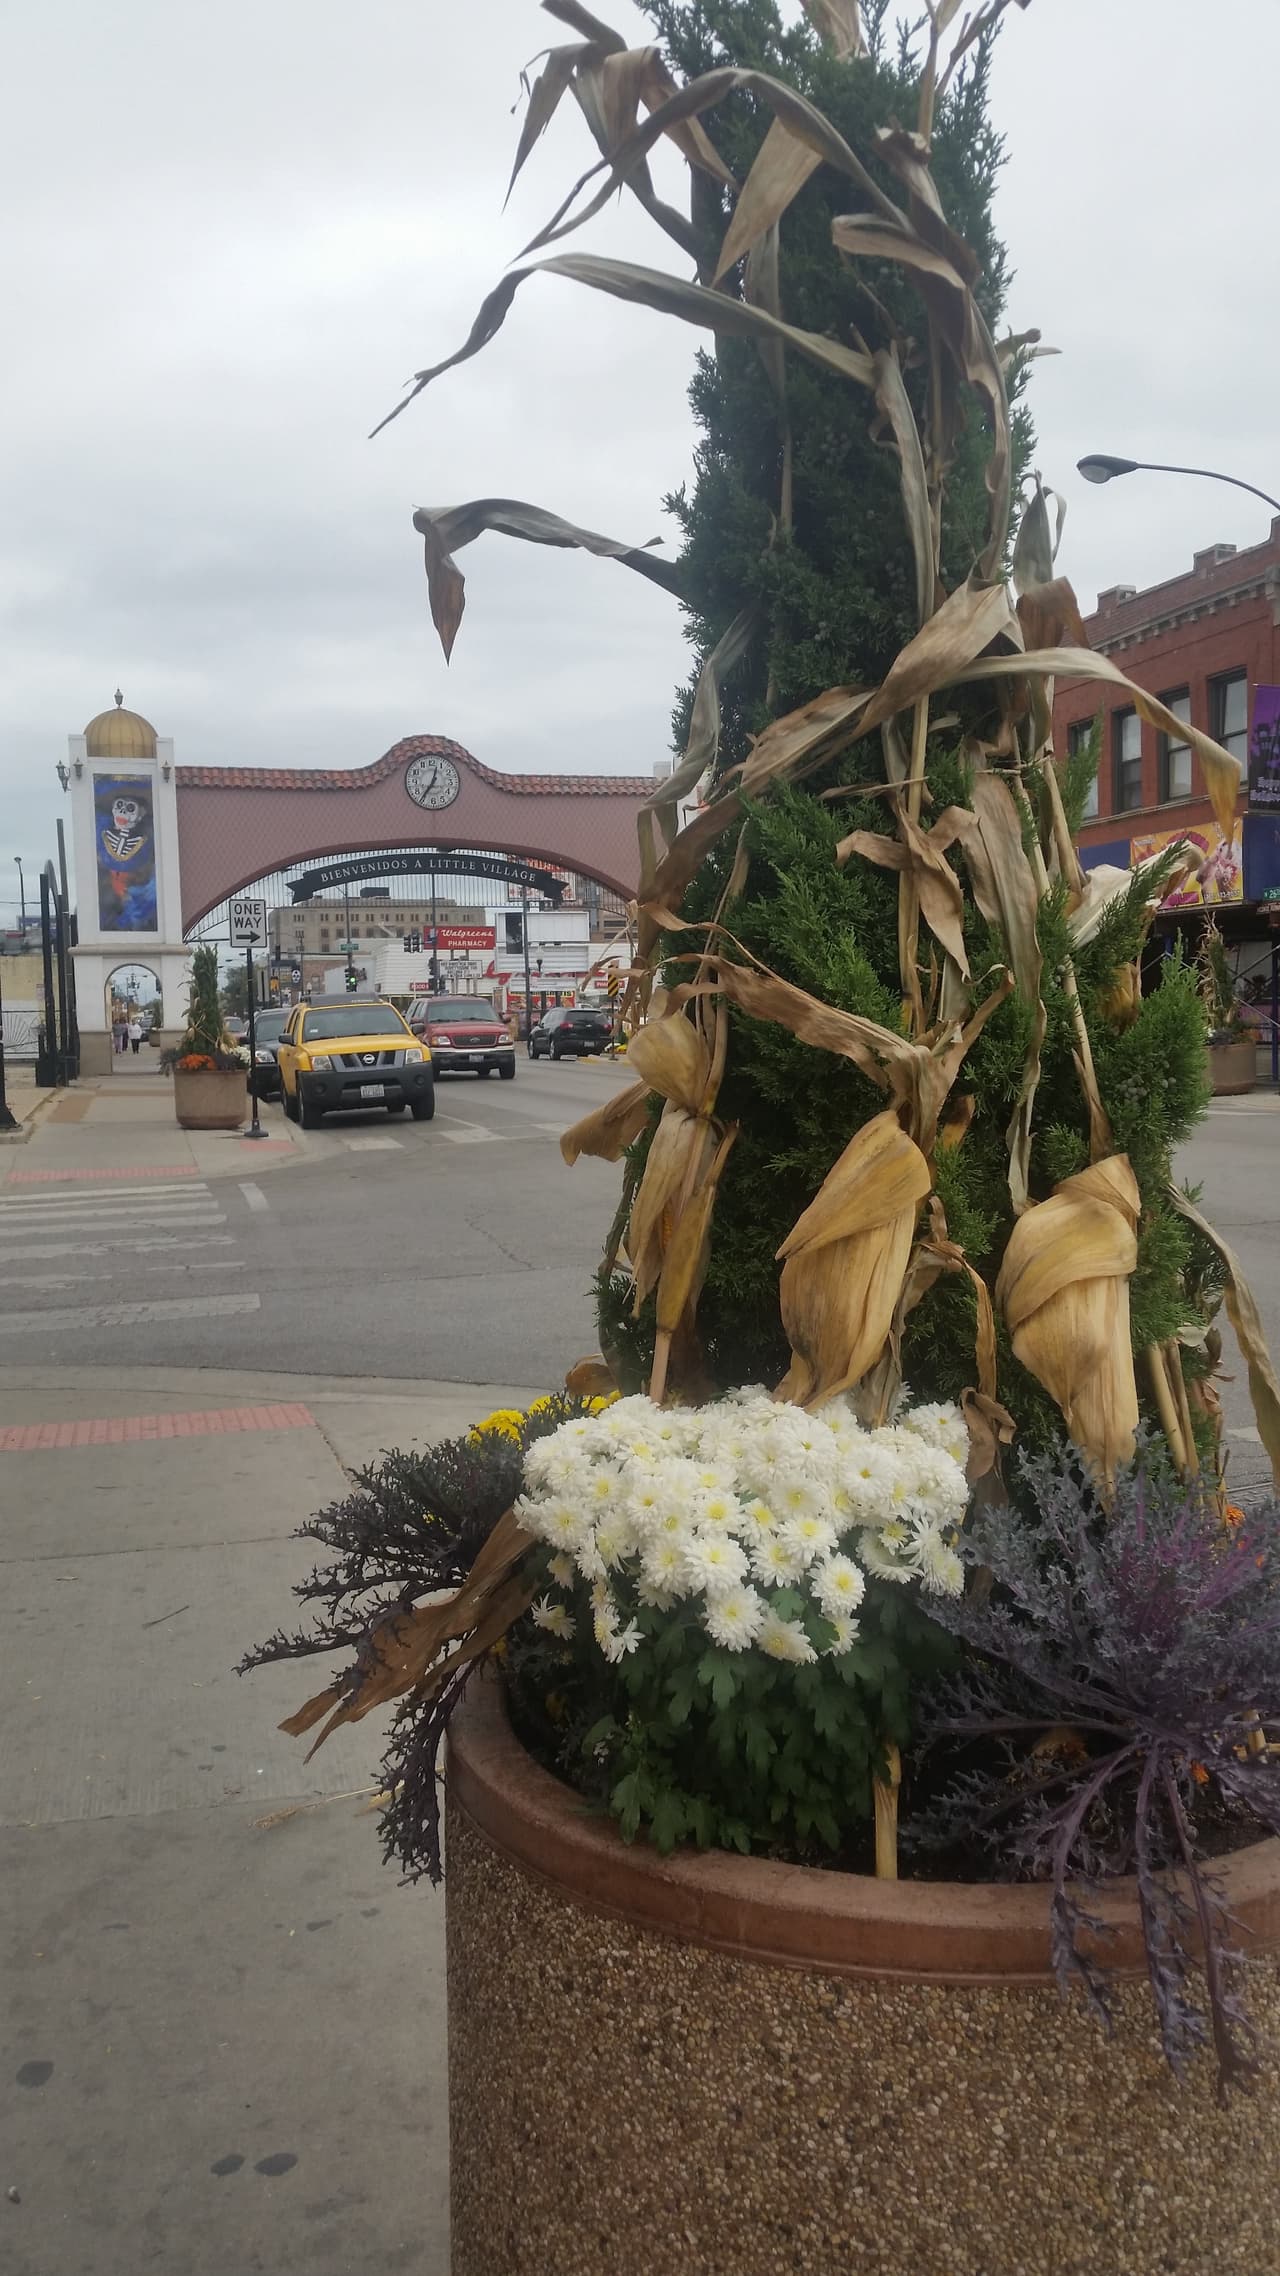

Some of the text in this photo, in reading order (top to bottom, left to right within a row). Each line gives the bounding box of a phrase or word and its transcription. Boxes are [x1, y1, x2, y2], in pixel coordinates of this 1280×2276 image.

[320, 859, 408, 882] BIENVENIDOS
[414, 859, 423, 868] A
[429, 859, 476, 870] LITTLE
[481, 863, 537, 882] VILLAGE
[234, 903, 261, 915] ONE
[234, 917, 262, 928] WAY
[441, 929, 494, 938] Walgreens
